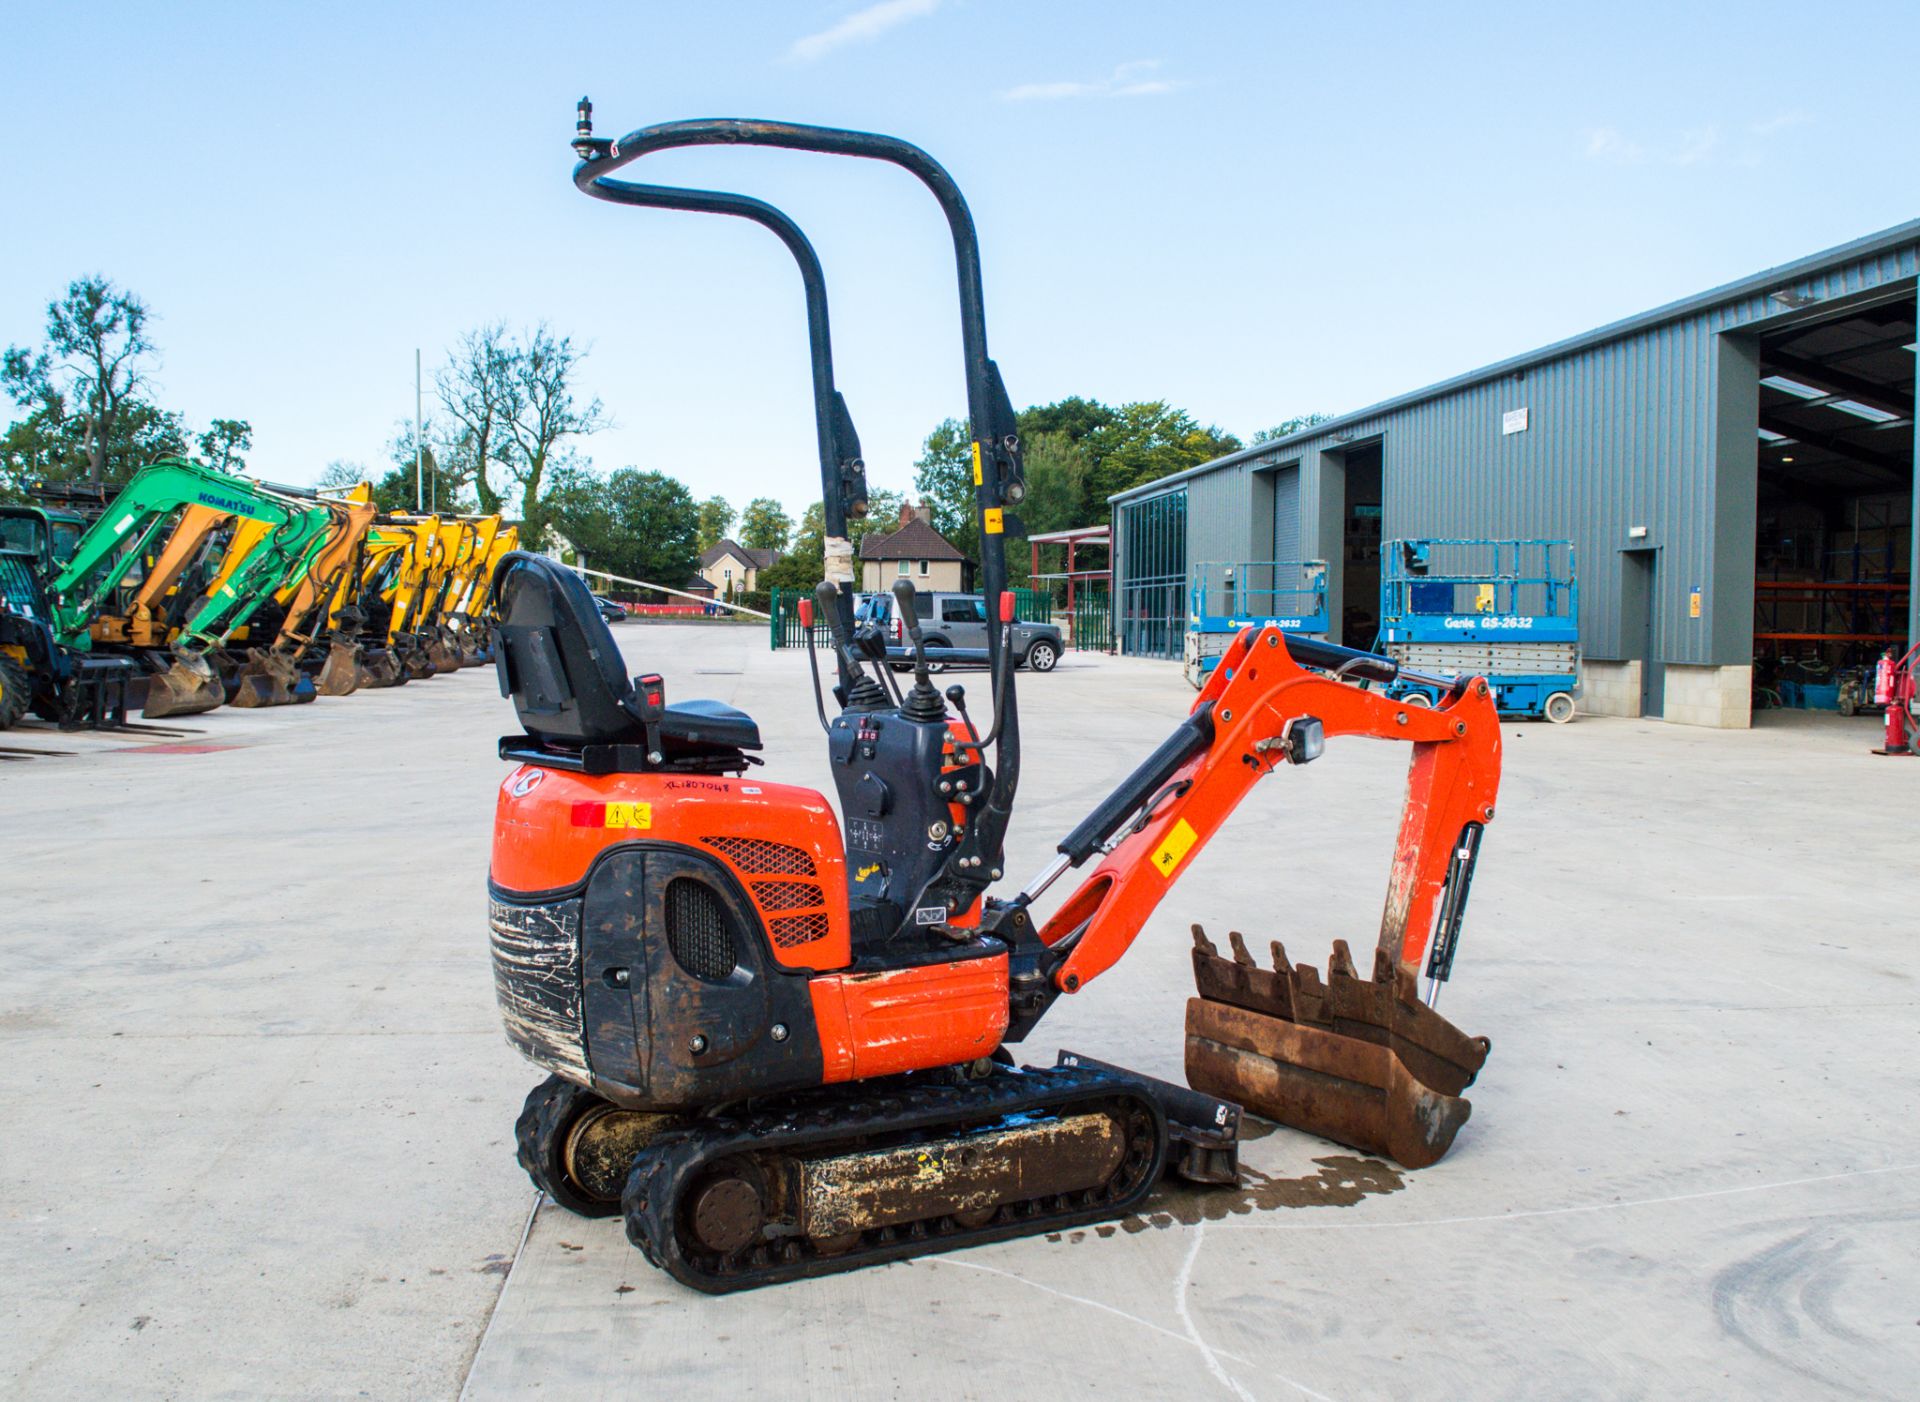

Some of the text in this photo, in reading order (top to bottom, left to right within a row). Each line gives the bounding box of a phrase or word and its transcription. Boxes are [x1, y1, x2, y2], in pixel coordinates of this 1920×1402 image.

[198, 492, 255, 515] KOMATSU
[1444, 617, 1533, 629] Genie GS-2632
